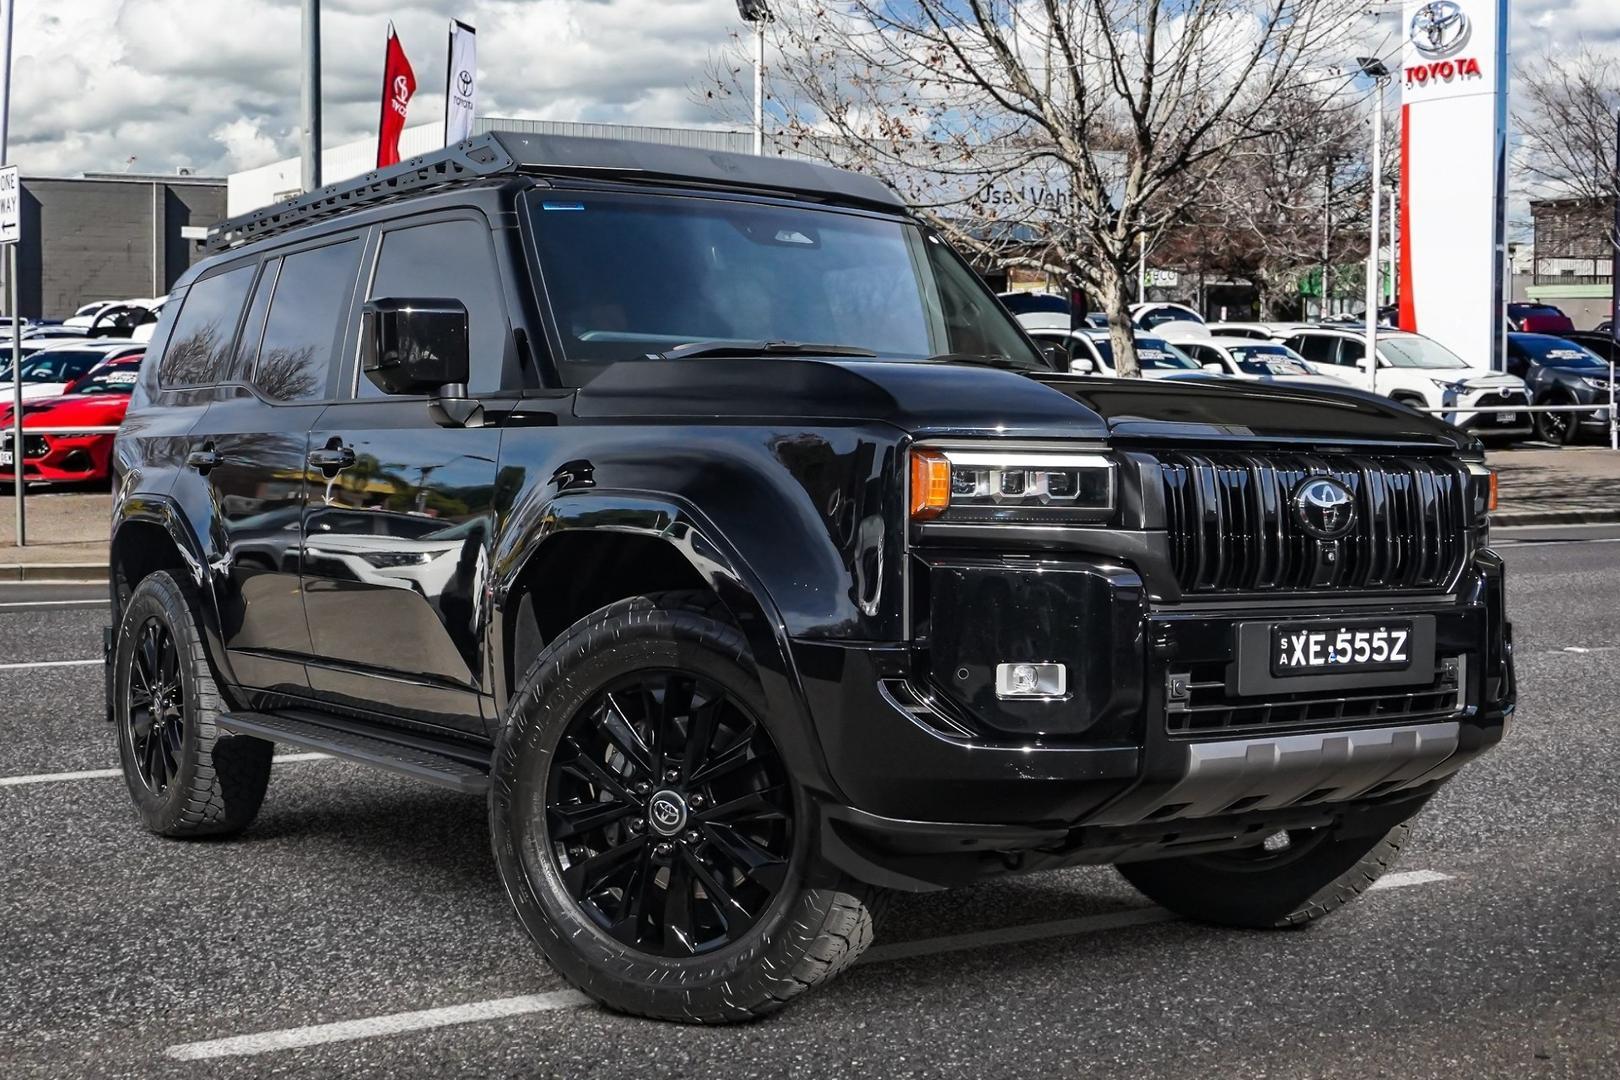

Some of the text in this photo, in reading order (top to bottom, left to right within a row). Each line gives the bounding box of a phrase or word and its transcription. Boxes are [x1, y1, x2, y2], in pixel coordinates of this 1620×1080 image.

[1404, 58, 1480, 83] TOYOTA
[1, 173, 15, 191] ONE
[0, 196, 17, 213] WAY
[979, 184, 1025, 205] Used
[1290, 631, 1407, 666] XE 555Z
